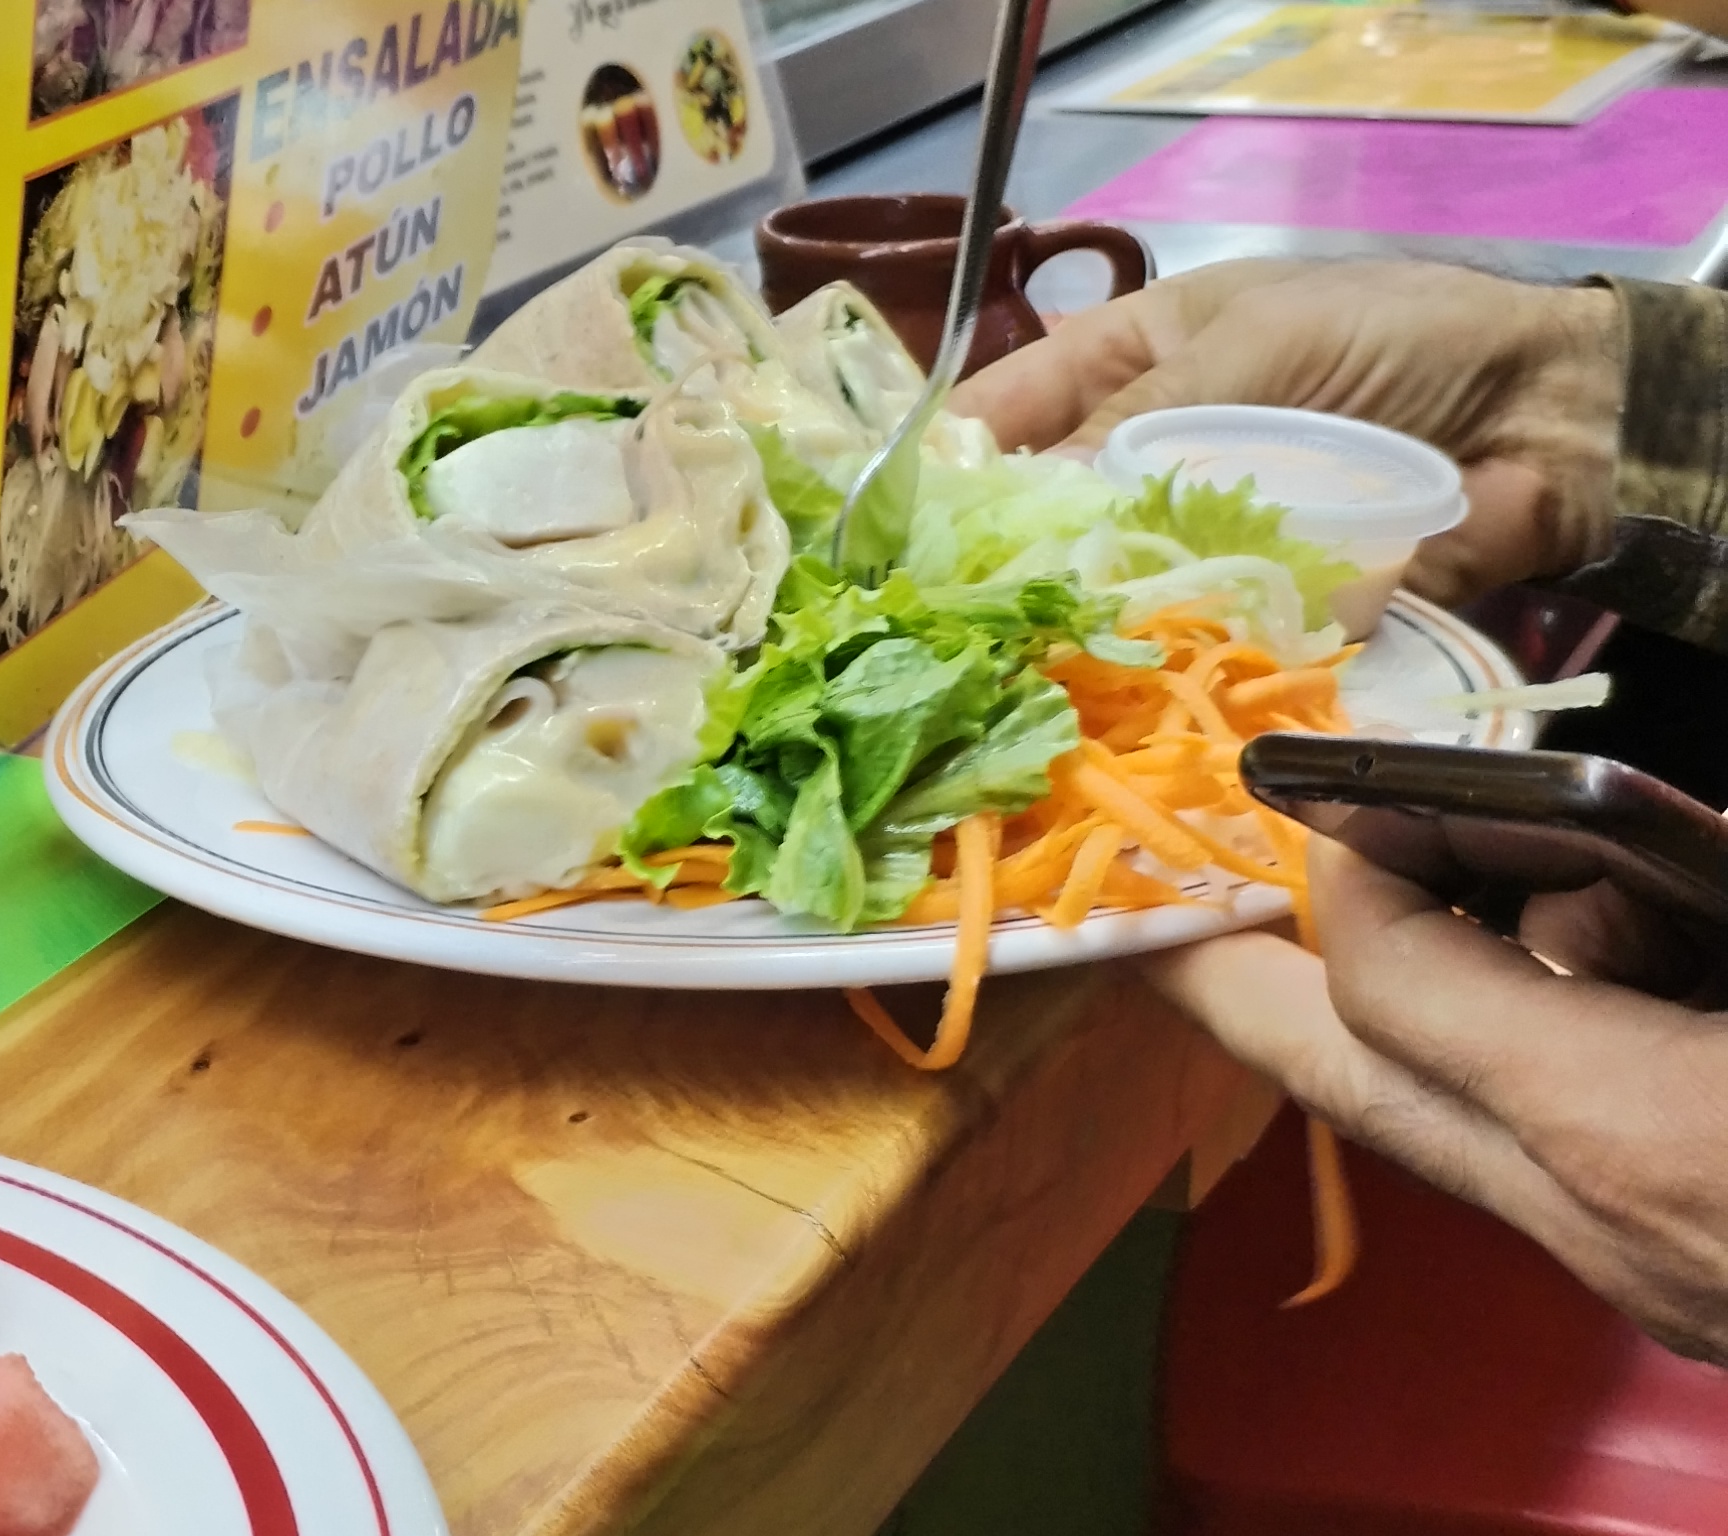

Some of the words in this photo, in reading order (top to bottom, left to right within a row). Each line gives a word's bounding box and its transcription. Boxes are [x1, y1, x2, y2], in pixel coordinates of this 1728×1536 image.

[323, 95, 477, 217] POLLO
[308, 197, 442, 321] ATÚN
[297, 264, 463, 413] JAMÓN
